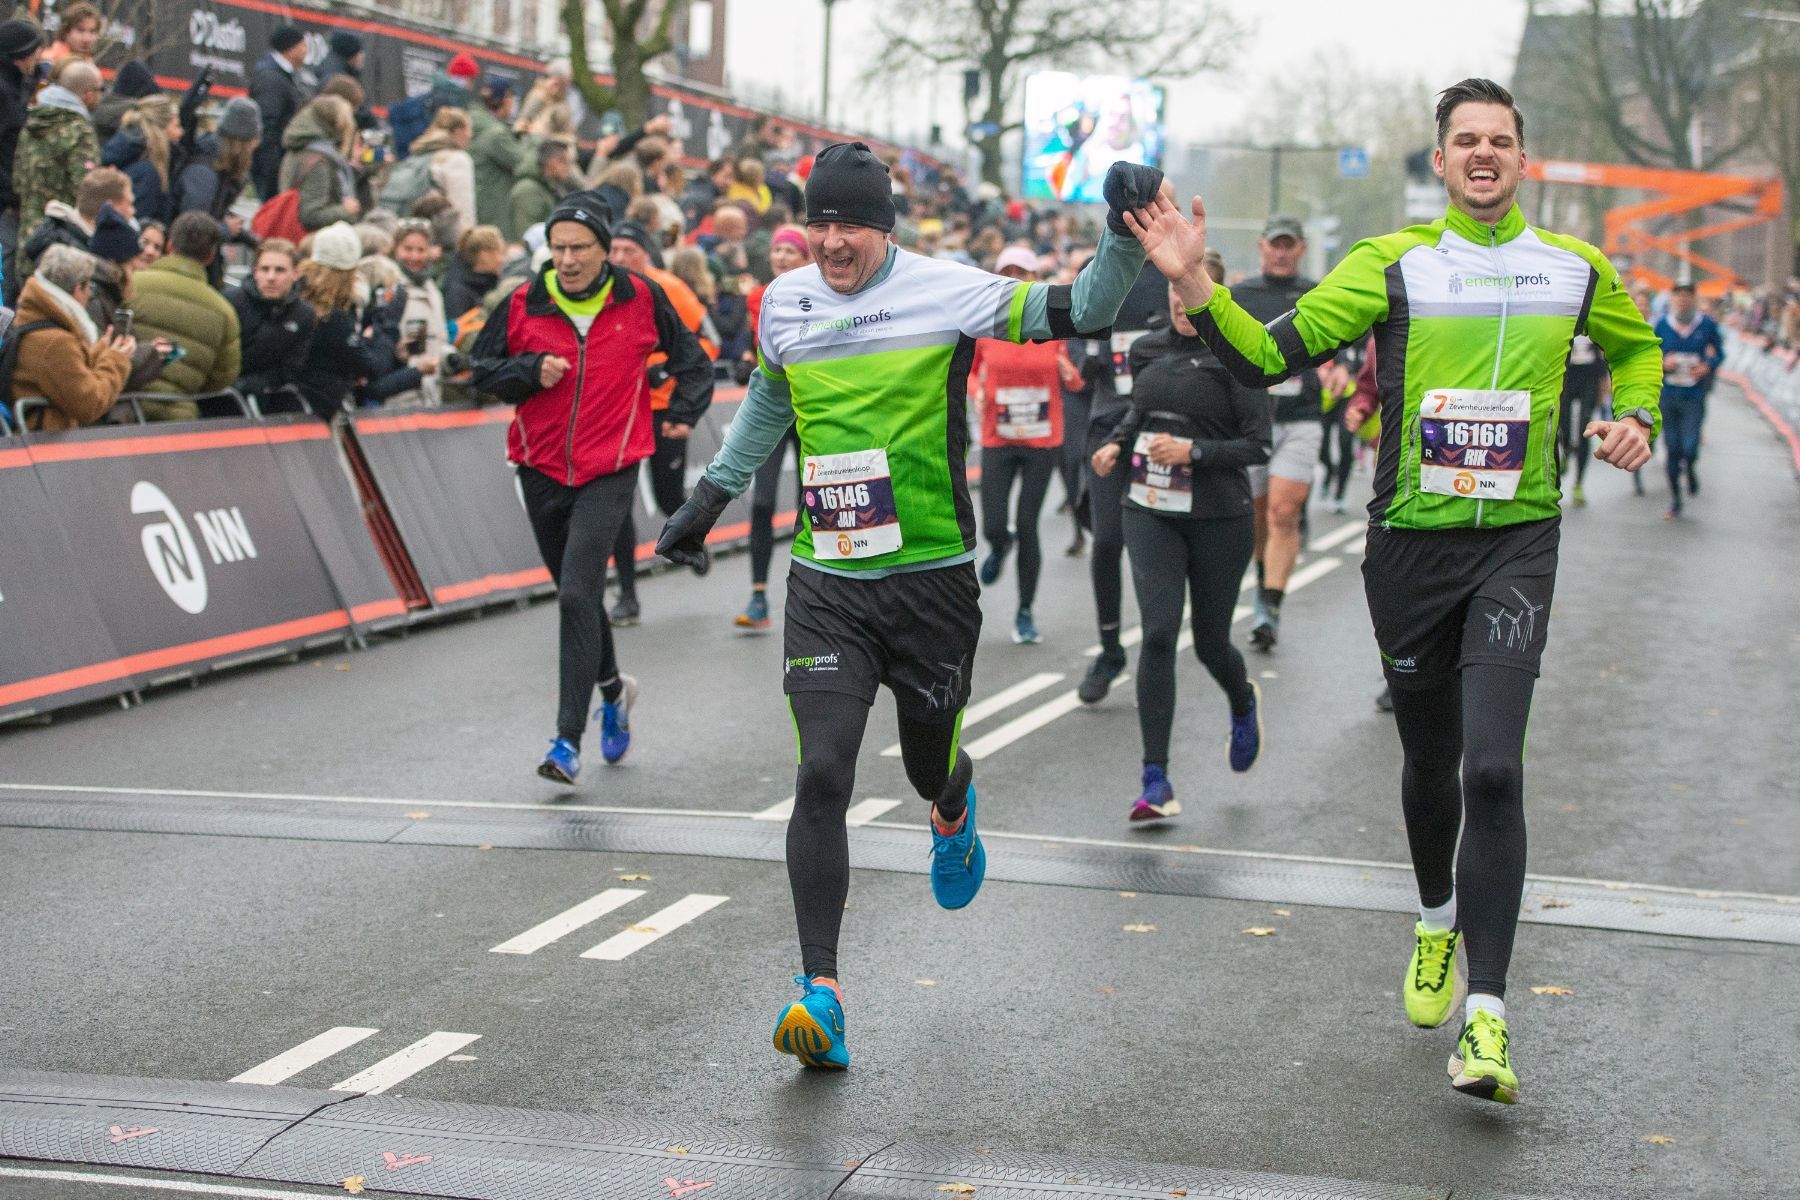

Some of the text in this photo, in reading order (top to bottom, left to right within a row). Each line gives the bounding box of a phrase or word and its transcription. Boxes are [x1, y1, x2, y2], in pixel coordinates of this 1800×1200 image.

[1464, 273, 1550, 289] energyprofs
[810, 309, 892, 332] energyprofs
[1433, 395, 1448, 414] 7
[1449, 403, 1514, 413] Zevenheuvelenloop
[1443, 421, 1509, 447] 16168
[1425, 448, 1433, 459] R
[1463, 448, 1488, 467] RIK
[807, 463, 816, 481] 7
[1479, 480, 1496, 489] NN
[818, 483, 871, 510] 16146
[812, 515, 819, 525] R
[837, 511, 856, 528] JAN
[193, 506, 257, 565] NN
[853, 540, 868, 549] NN
[789, 653, 839, 667] energyprofs
